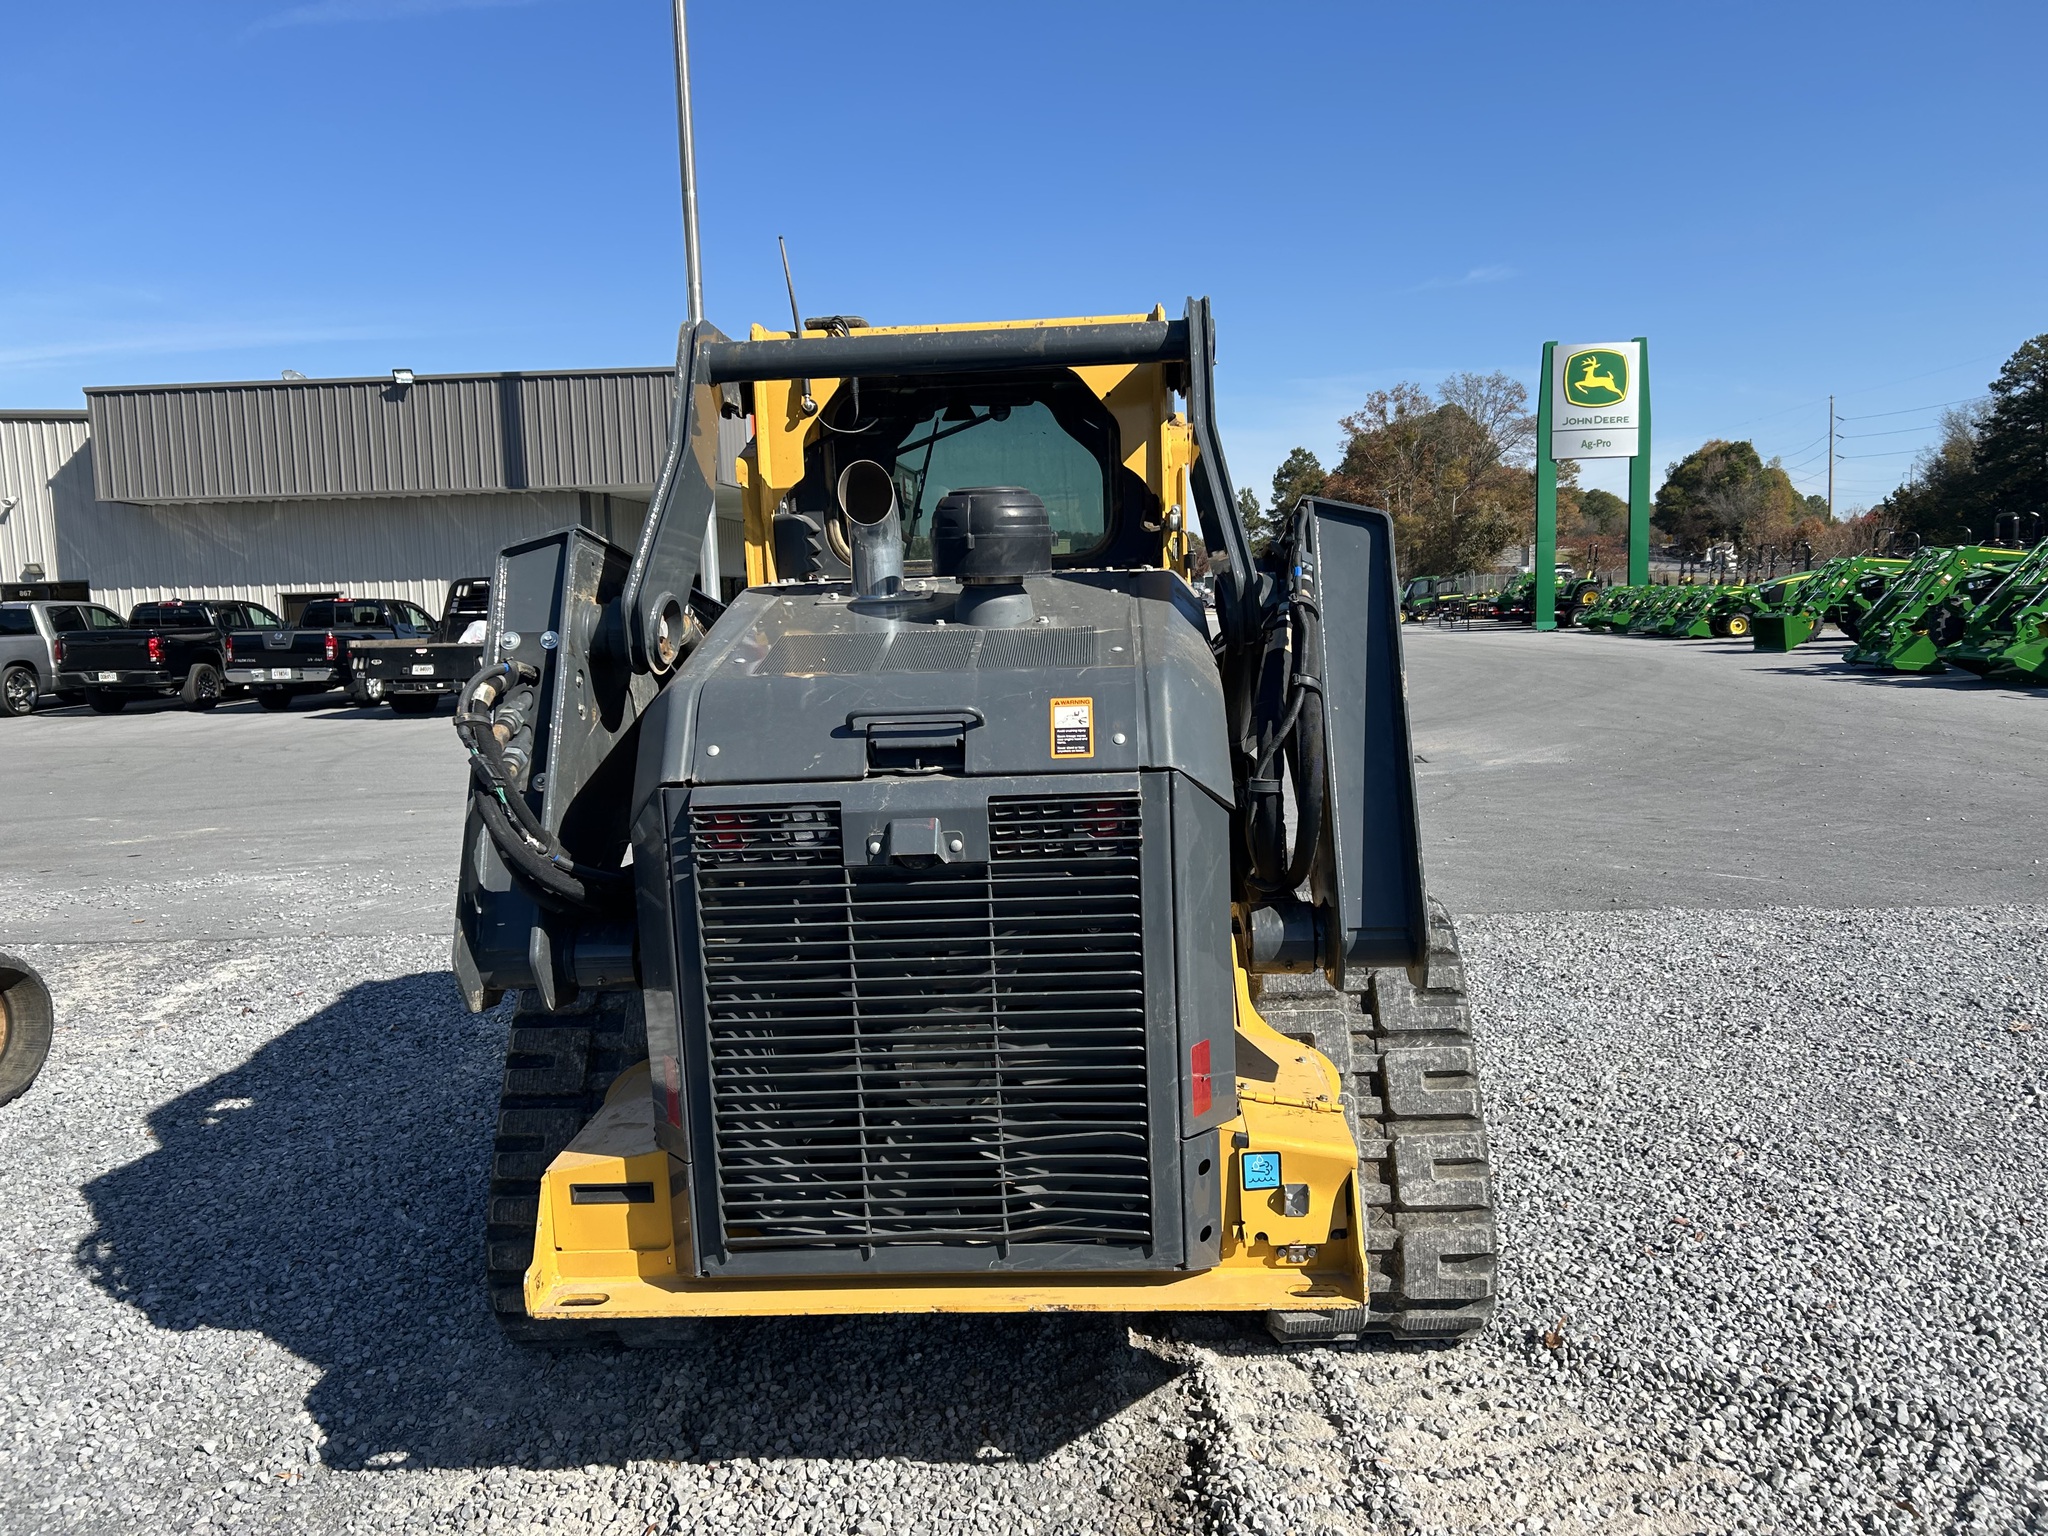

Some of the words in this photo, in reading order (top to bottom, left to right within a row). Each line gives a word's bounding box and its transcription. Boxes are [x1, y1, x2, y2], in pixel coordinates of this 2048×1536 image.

[1562, 416, 1592, 426] JOHN
[1594, 415, 1629, 425] DEERE
[1581, 439, 1611, 450] Ag-Pro
